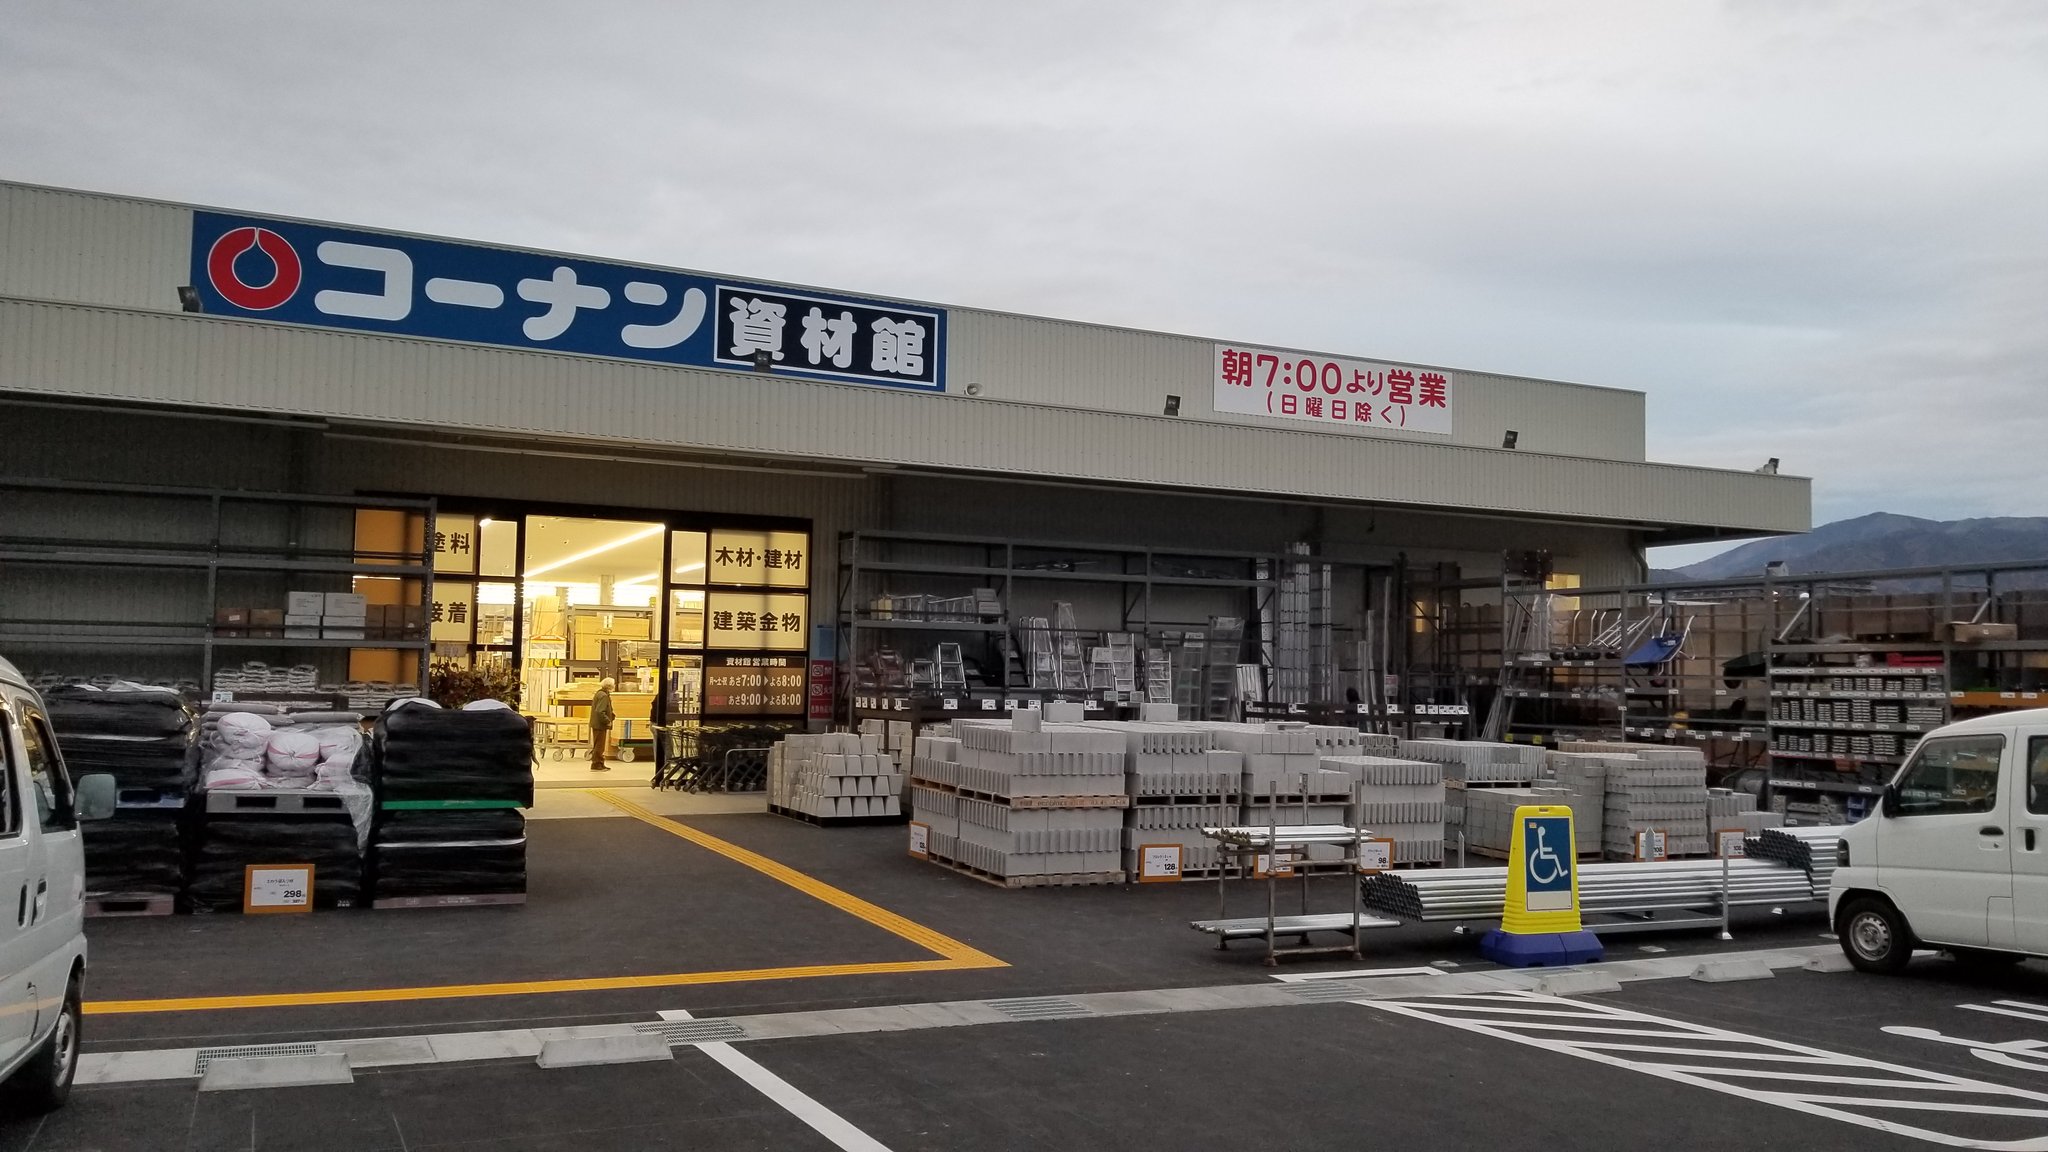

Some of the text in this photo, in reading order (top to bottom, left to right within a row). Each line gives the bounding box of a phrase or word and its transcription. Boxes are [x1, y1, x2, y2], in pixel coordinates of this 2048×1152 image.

[315, 241, 927, 378] コーナン 資材館
[1221, 349, 1447, 409] 朝7:00より営業
[715, 546, 803, 570] 木材・建材
[713, 610, 801, 633] 建築金物
[1164, 863, 1176, 871] 128
[283, 890, 302, 898] 298
